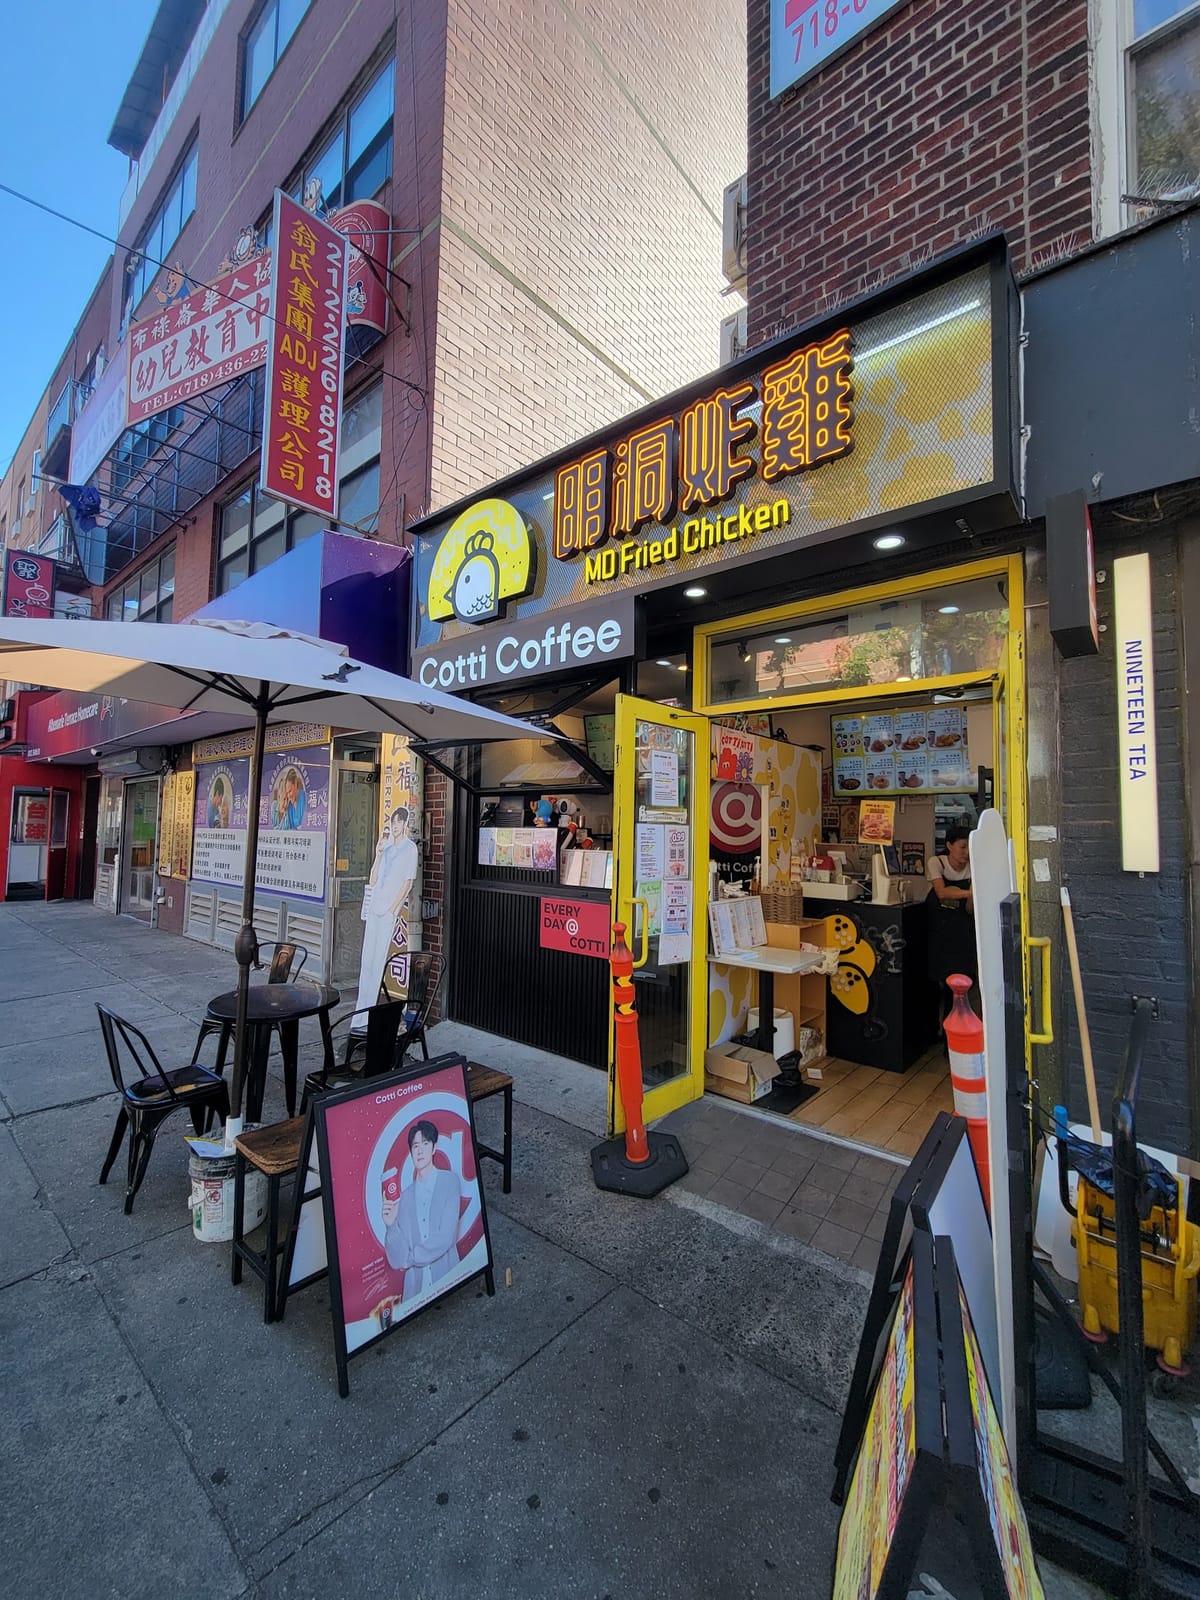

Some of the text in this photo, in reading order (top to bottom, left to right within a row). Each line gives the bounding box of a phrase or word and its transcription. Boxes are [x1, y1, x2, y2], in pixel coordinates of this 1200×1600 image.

[135, 292, 270, 393] 幼兒教育中
[553, 329, 855, 561] 明洞炸雞
[585, 499, 789, 584] MD Fried Chicken
[419, 619, 622, 689] Cotti Coffee
[1125, 640, 1147, 780] NINETEEN TEA
[383, 763, 393, 840] TERRACE
[544, 903, 581, 918] EVERY
[544, 917, 567, 931] DAY
[570, 937, 605, 953] COTTI
[375, 1083, 423, 1104] Cotti Coffee
